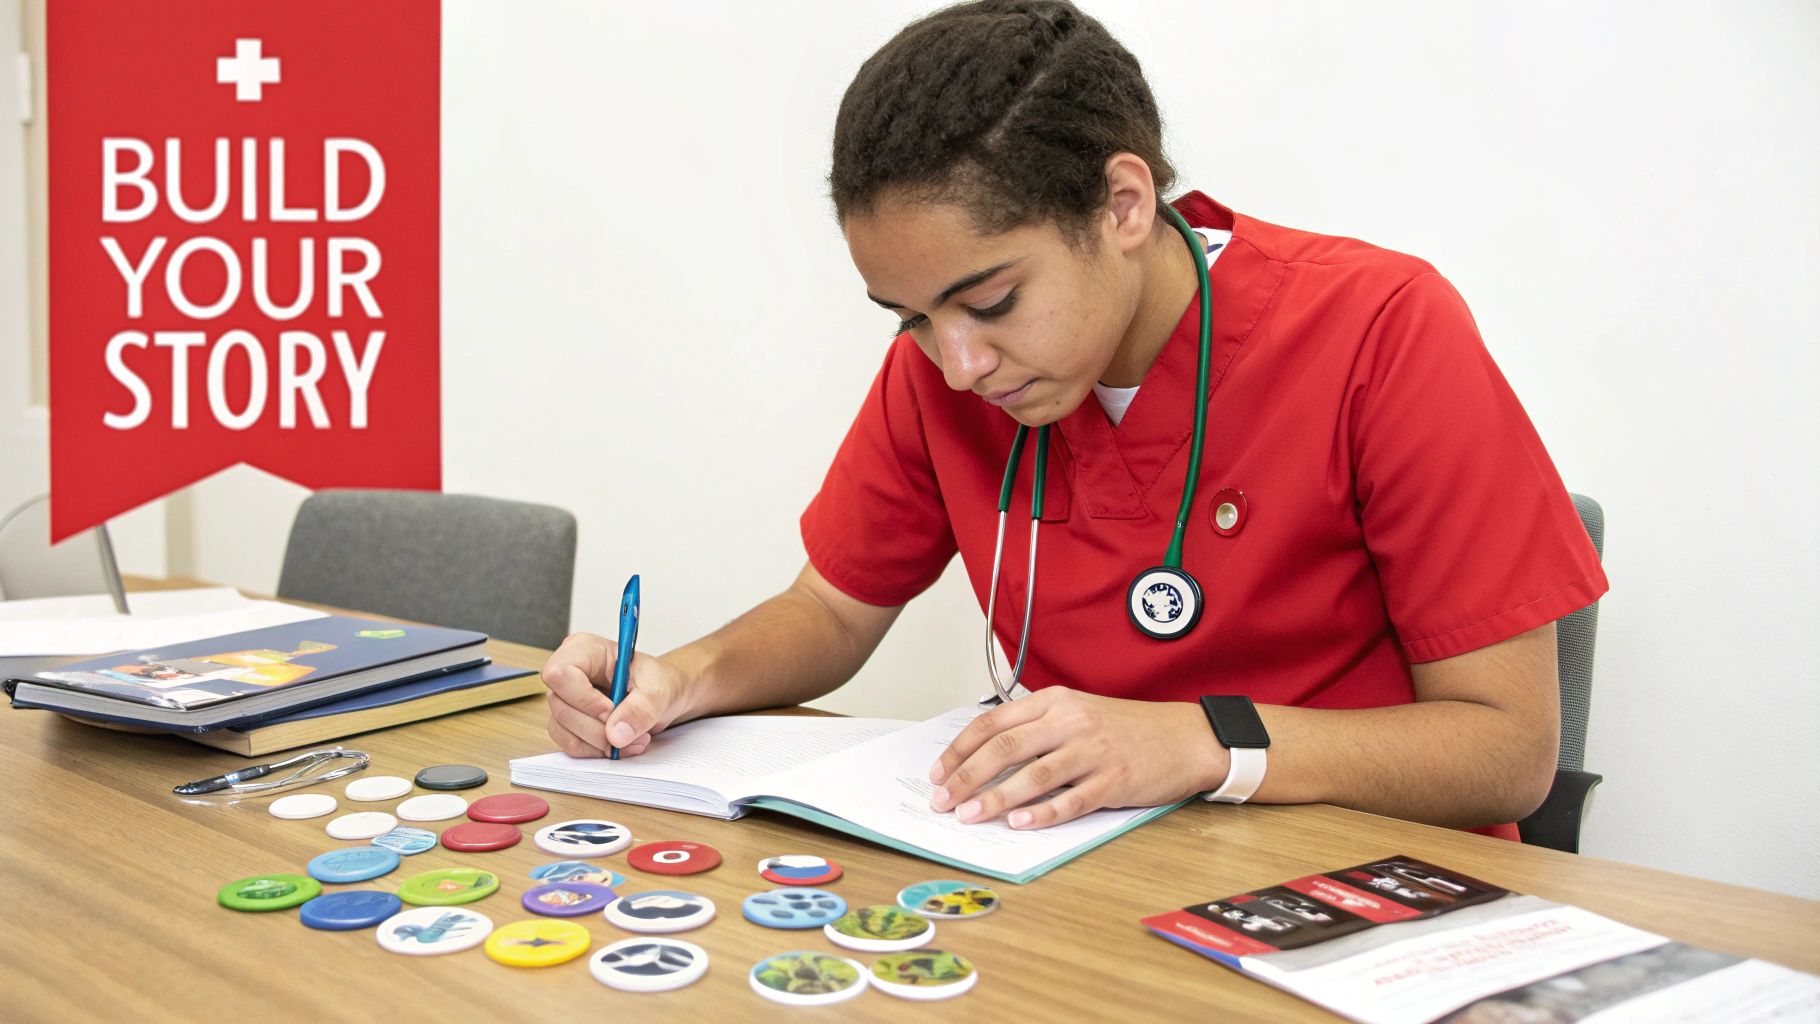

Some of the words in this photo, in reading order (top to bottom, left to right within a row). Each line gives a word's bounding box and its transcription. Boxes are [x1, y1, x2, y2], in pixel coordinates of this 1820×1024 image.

[102, 137, 386, 222] BUILD
[100, 236, 383, 320] YOUR
[103, 329, 386, 430] STORY
